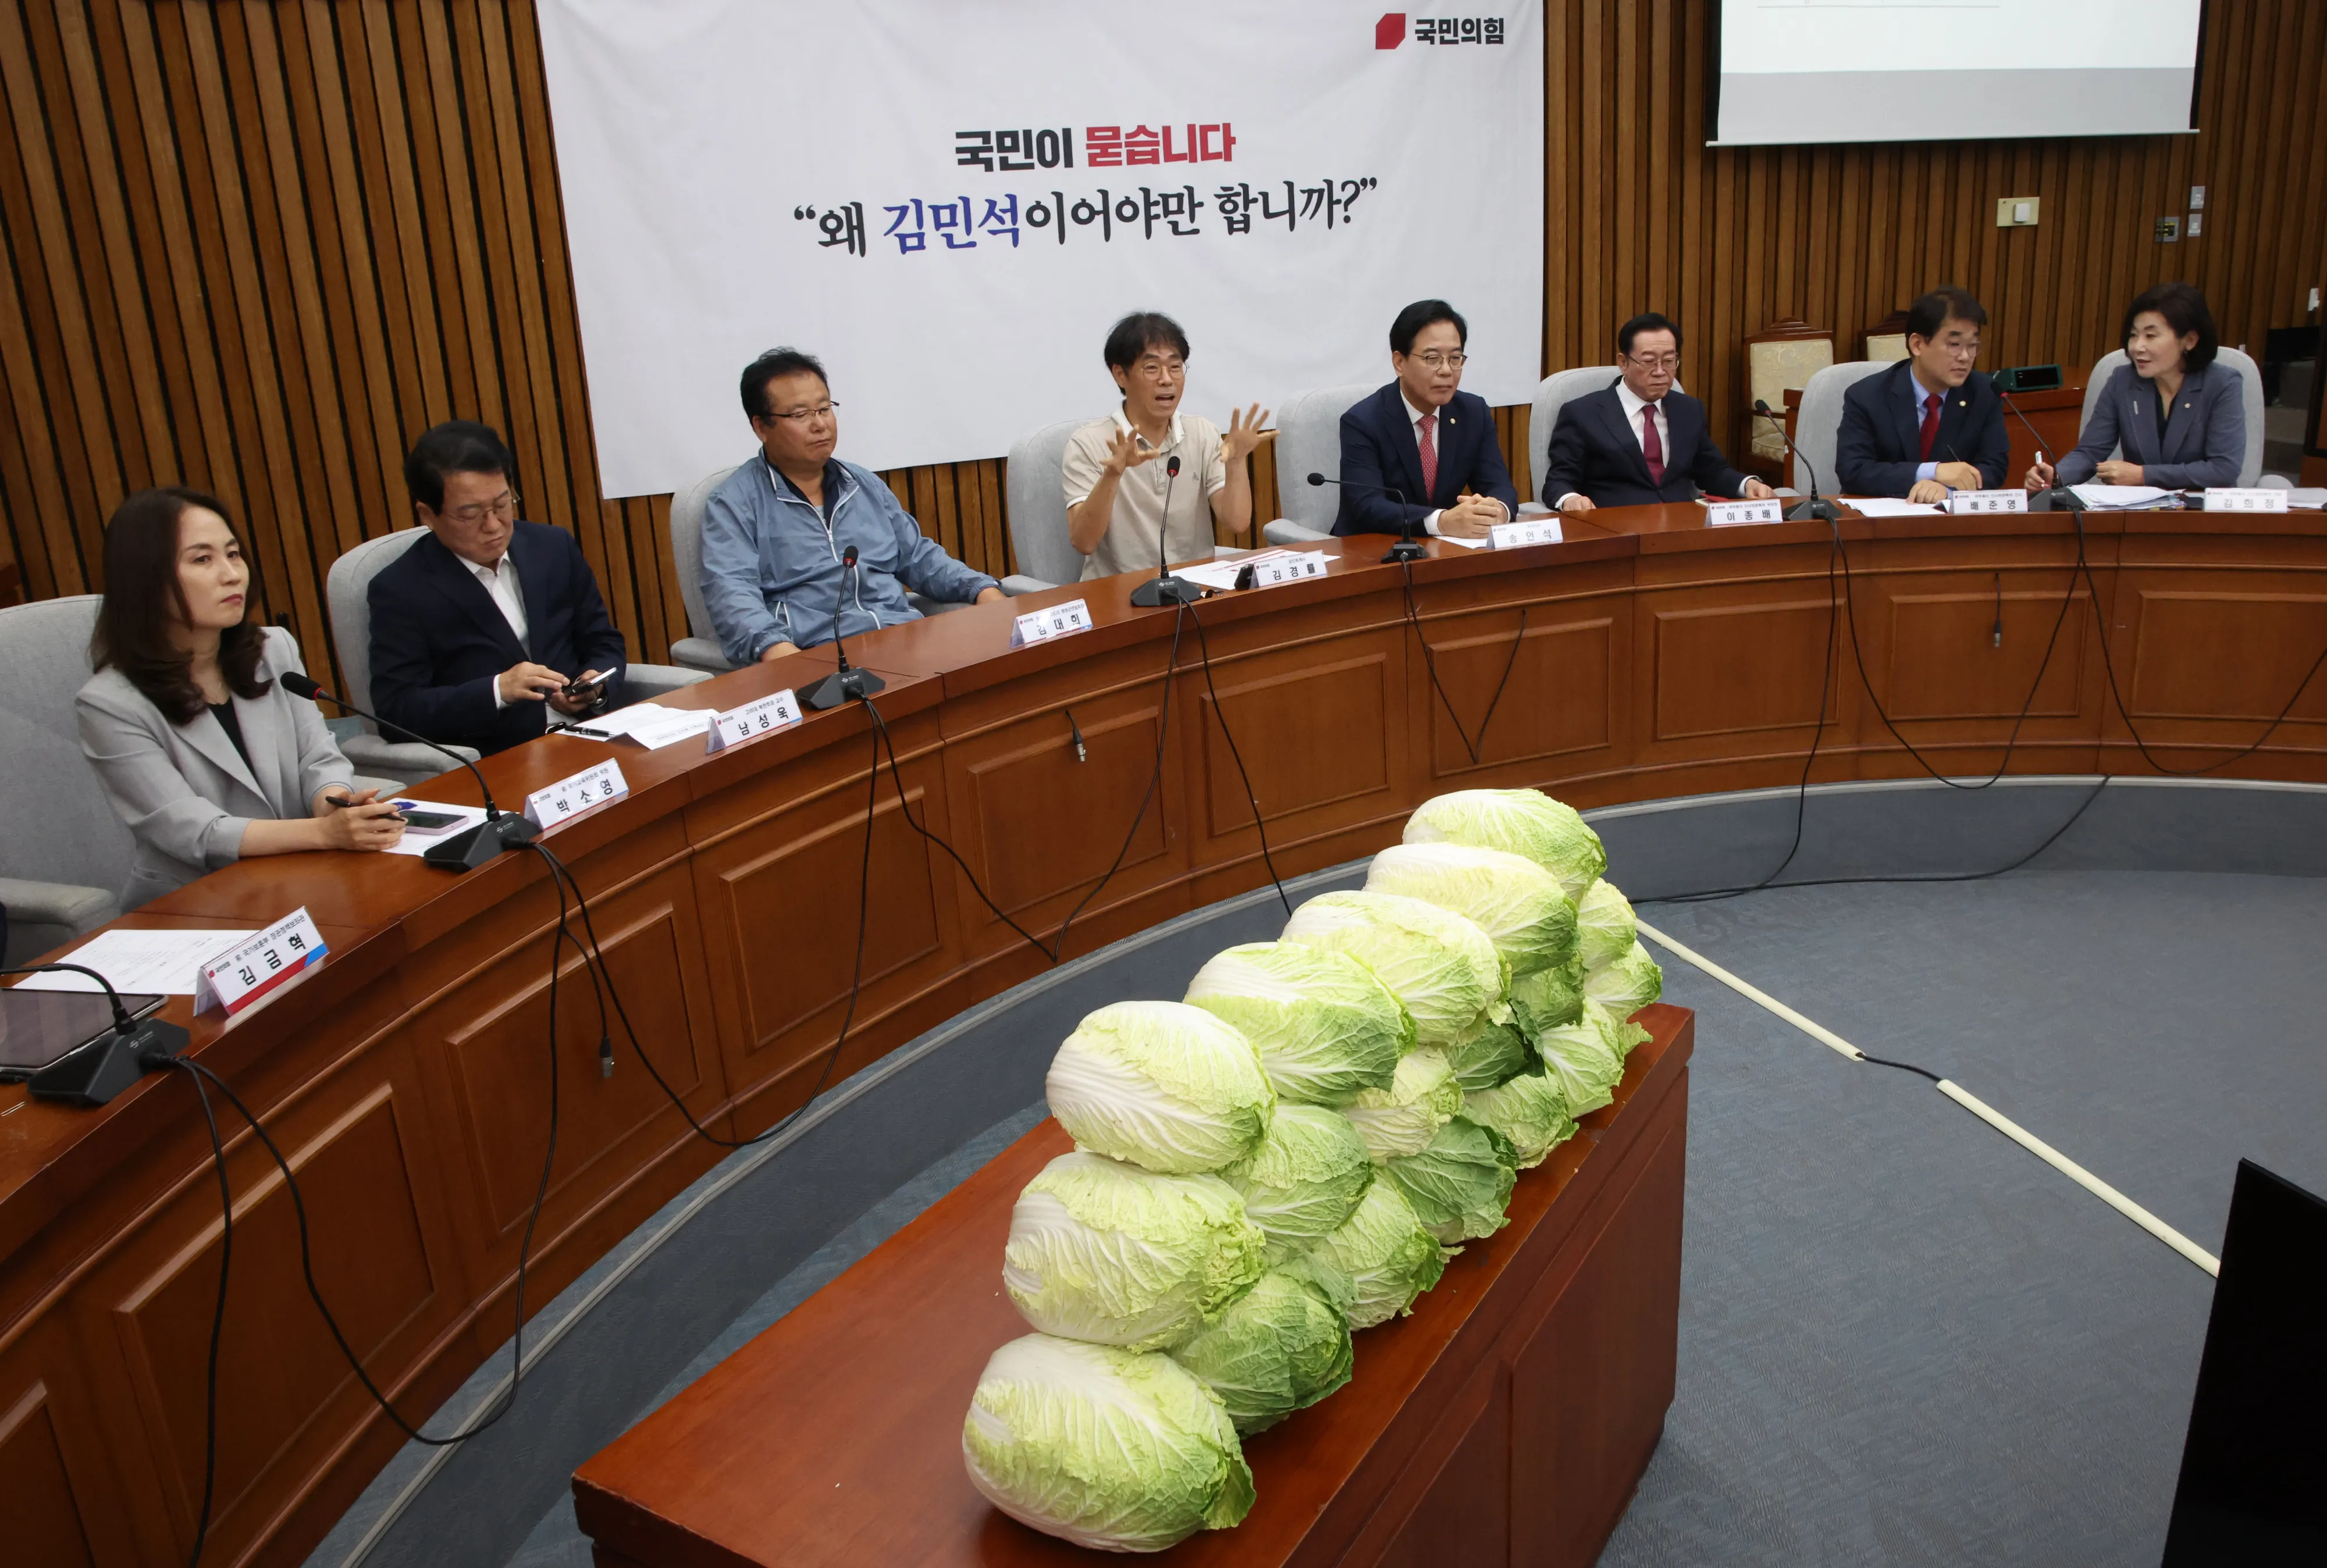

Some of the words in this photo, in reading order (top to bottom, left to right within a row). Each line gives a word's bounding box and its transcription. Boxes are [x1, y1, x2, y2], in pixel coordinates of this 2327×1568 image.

[1415, 17, 1504, 45] 국민의힘
[956, 128, 1073, 172] 국민이
[1086, 123, 1236, 167] 묻습니다
[884, 186, 1204, 254] 김민석이어야만
[243, 937, 269, 956] 국가보훈부
